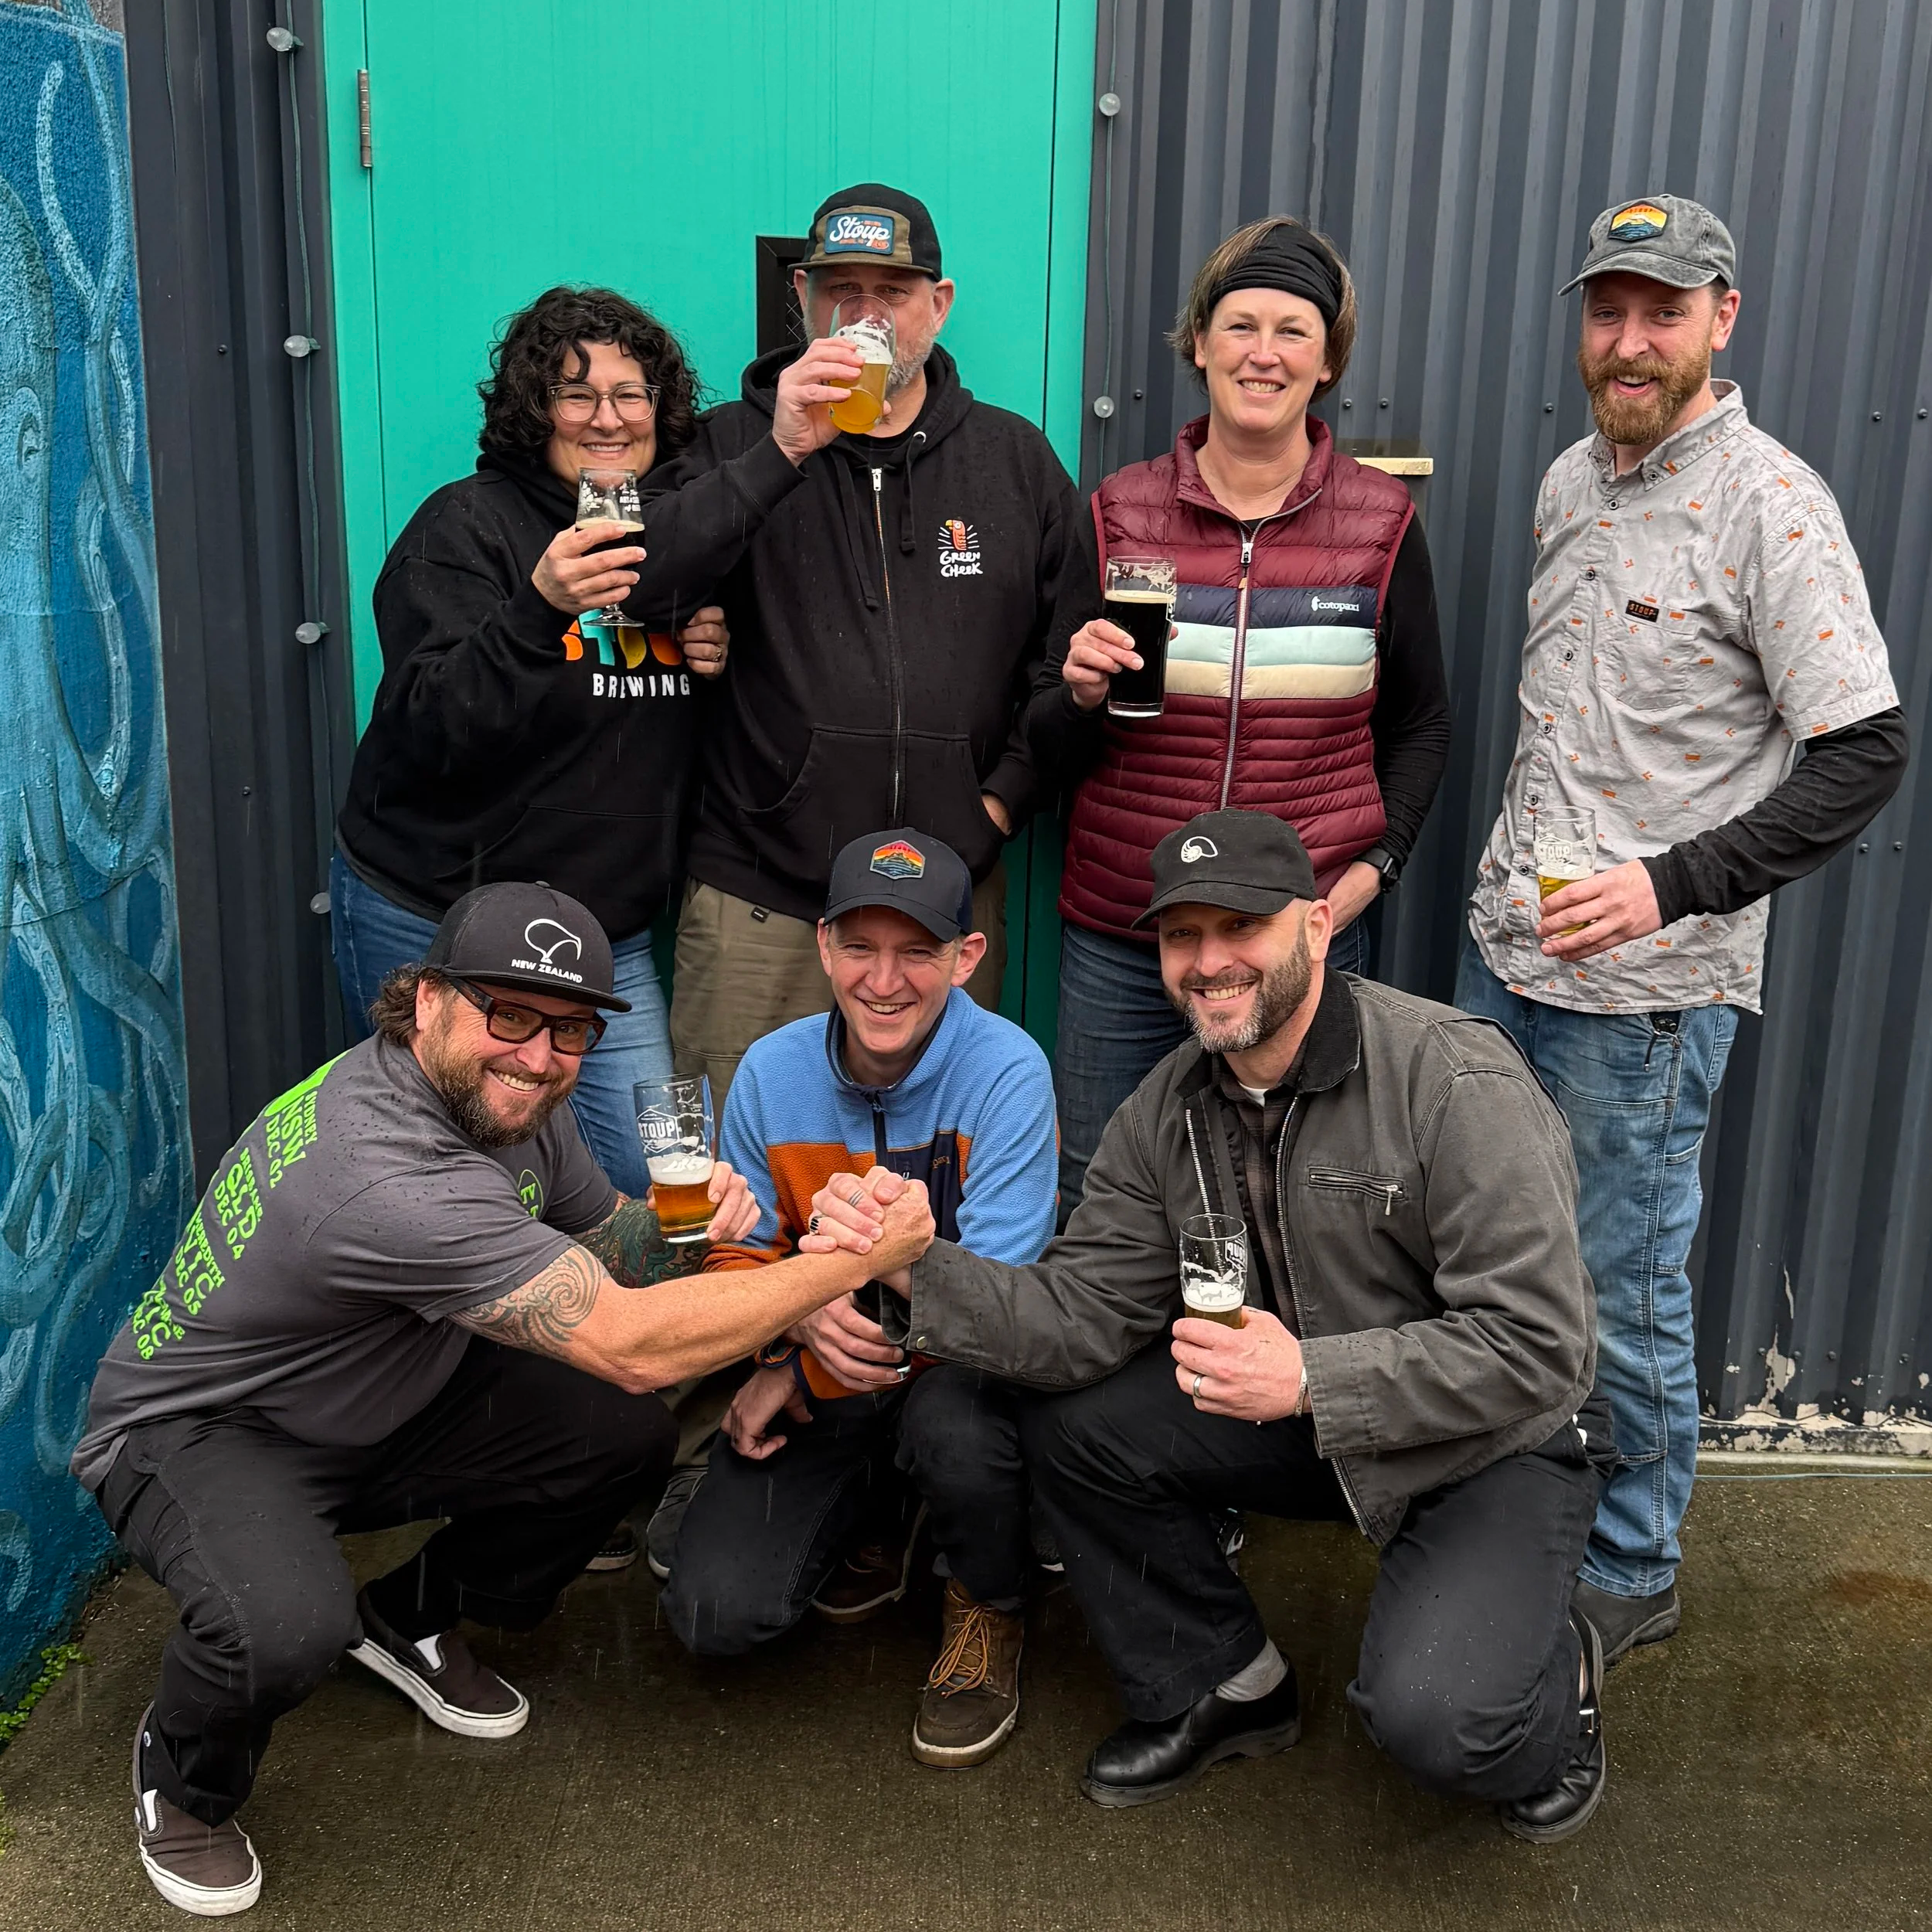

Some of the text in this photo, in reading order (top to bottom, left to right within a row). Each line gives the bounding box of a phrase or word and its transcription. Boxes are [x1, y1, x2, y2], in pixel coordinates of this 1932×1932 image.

[829, 216, 890, 247] Stoup
[1318, 602, 1359, 611] cotopaxi
[512, 959, 583, 983] NEW ZEALAND
[266, 1114, 283, 1189] DEC 02
[281, 1095, 306, 1167] NSW
[304, 1090, 318, 1145] SYDNEY
[638, 1121, 675, 1138] STOUP
[214, 1180, 245, 1260] DEC 04
[226, 1163, 257, 1239] QLD
[175, 1245, 202, 1315] DEC 05
[184, 1224, 215, 1299] VIC
[195, 1211, 226, 1288] MEREDITH
[137, 1334, 154, 1359] 08
